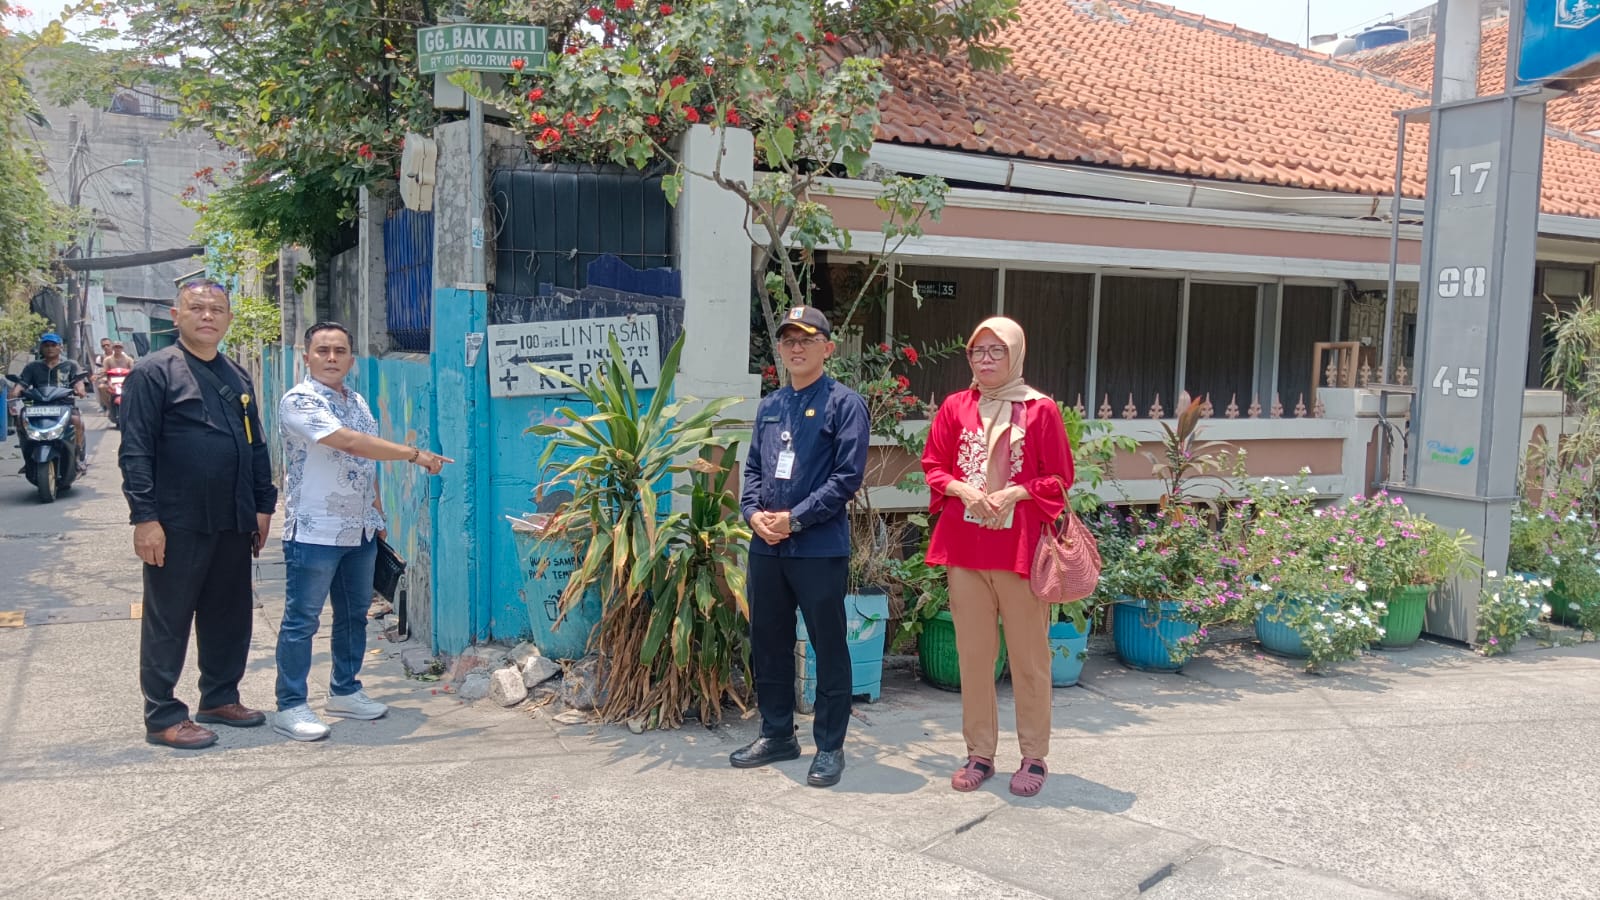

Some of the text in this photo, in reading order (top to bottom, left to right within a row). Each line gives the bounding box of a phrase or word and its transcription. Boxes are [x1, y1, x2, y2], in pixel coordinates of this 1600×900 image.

[425, 28, 536, 52] GG. BAK AIR I
[444, 55, 482, 66] 001-002
[1449, 161, 1492, 196] 17
[942, 285, 954, 296] 35
[1438, 266, 1487, 298] 08
[520, 334, 540, 350] 100
[561, 320, 651, 347] LINTASAN
[1432, 365, 1480, 398] 45
